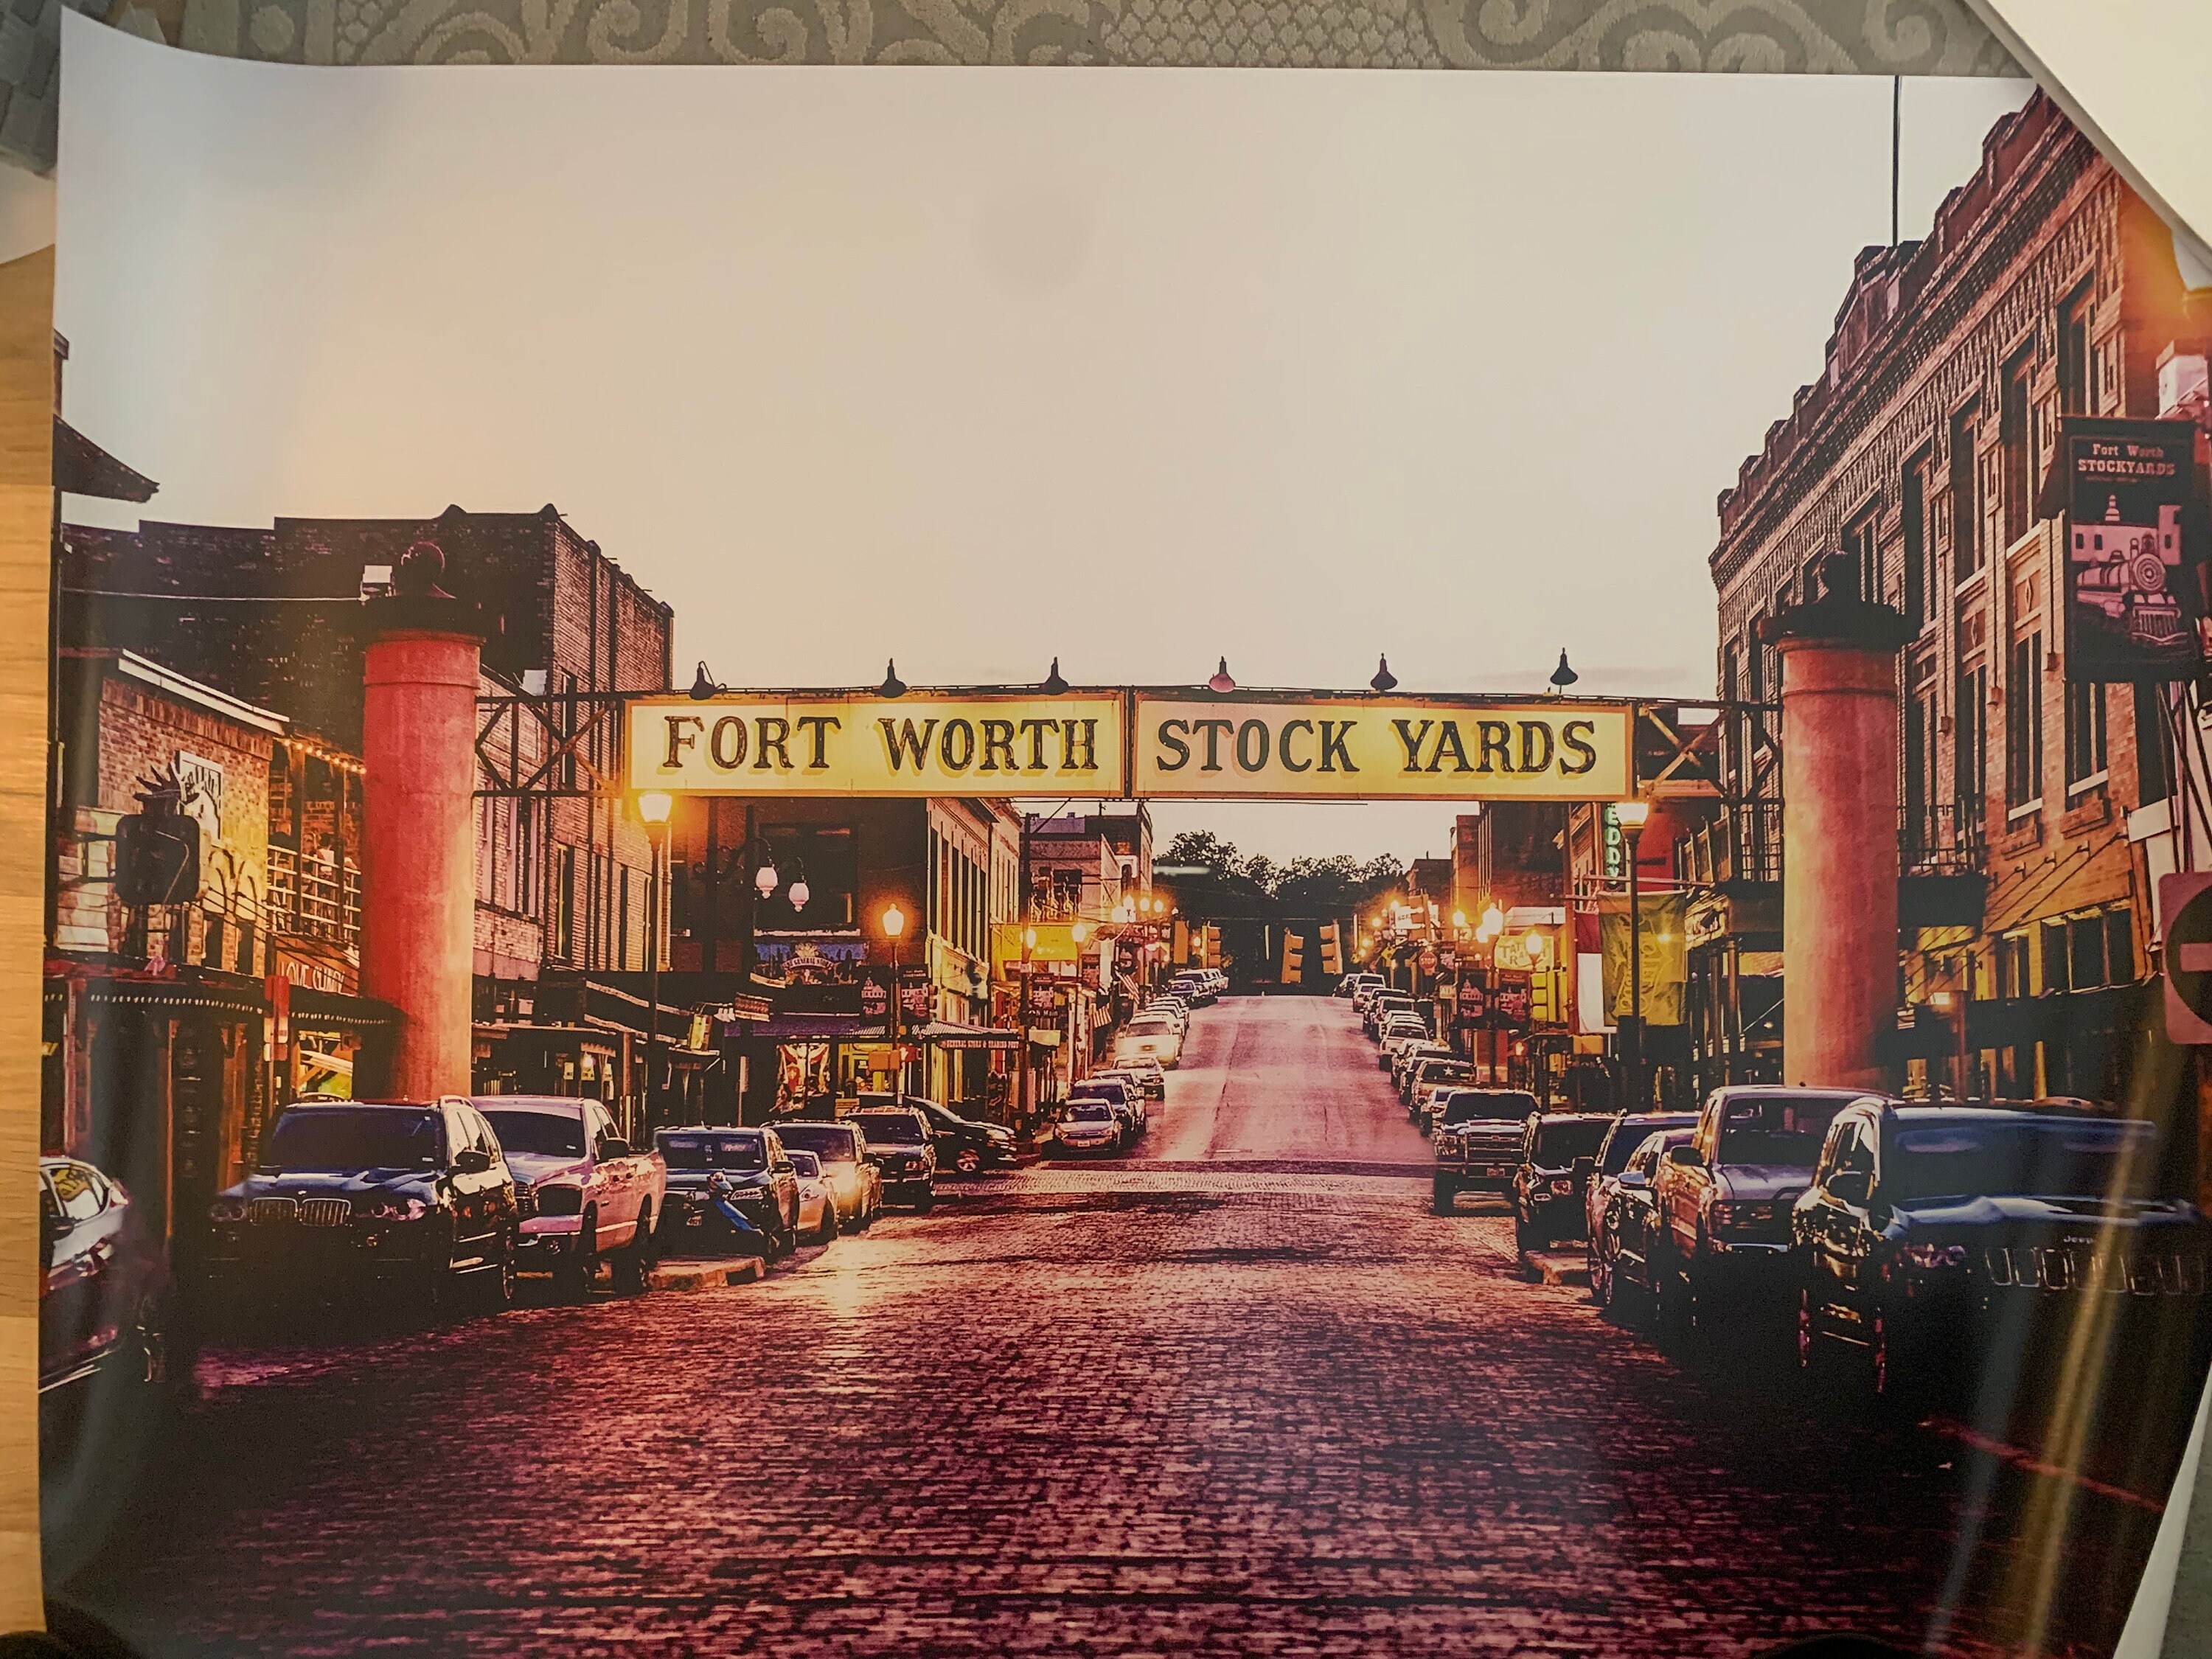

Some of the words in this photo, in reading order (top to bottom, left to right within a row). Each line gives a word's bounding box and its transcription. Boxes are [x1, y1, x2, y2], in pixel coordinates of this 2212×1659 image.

[2093, 443, 2119, 456] Fort
[2127, 445, 2164, 458] Worth
[2078, 459, 2174, 476] STOCKYARDS
[662, 715, 841, 769] FORT
[877, 717, 1099, 771] WORTH
[1156, 719, 1360, 772] STOCK
[1391, 720, 1596, 774] YARDS
[1420, 957, 1436, 965] STOP
